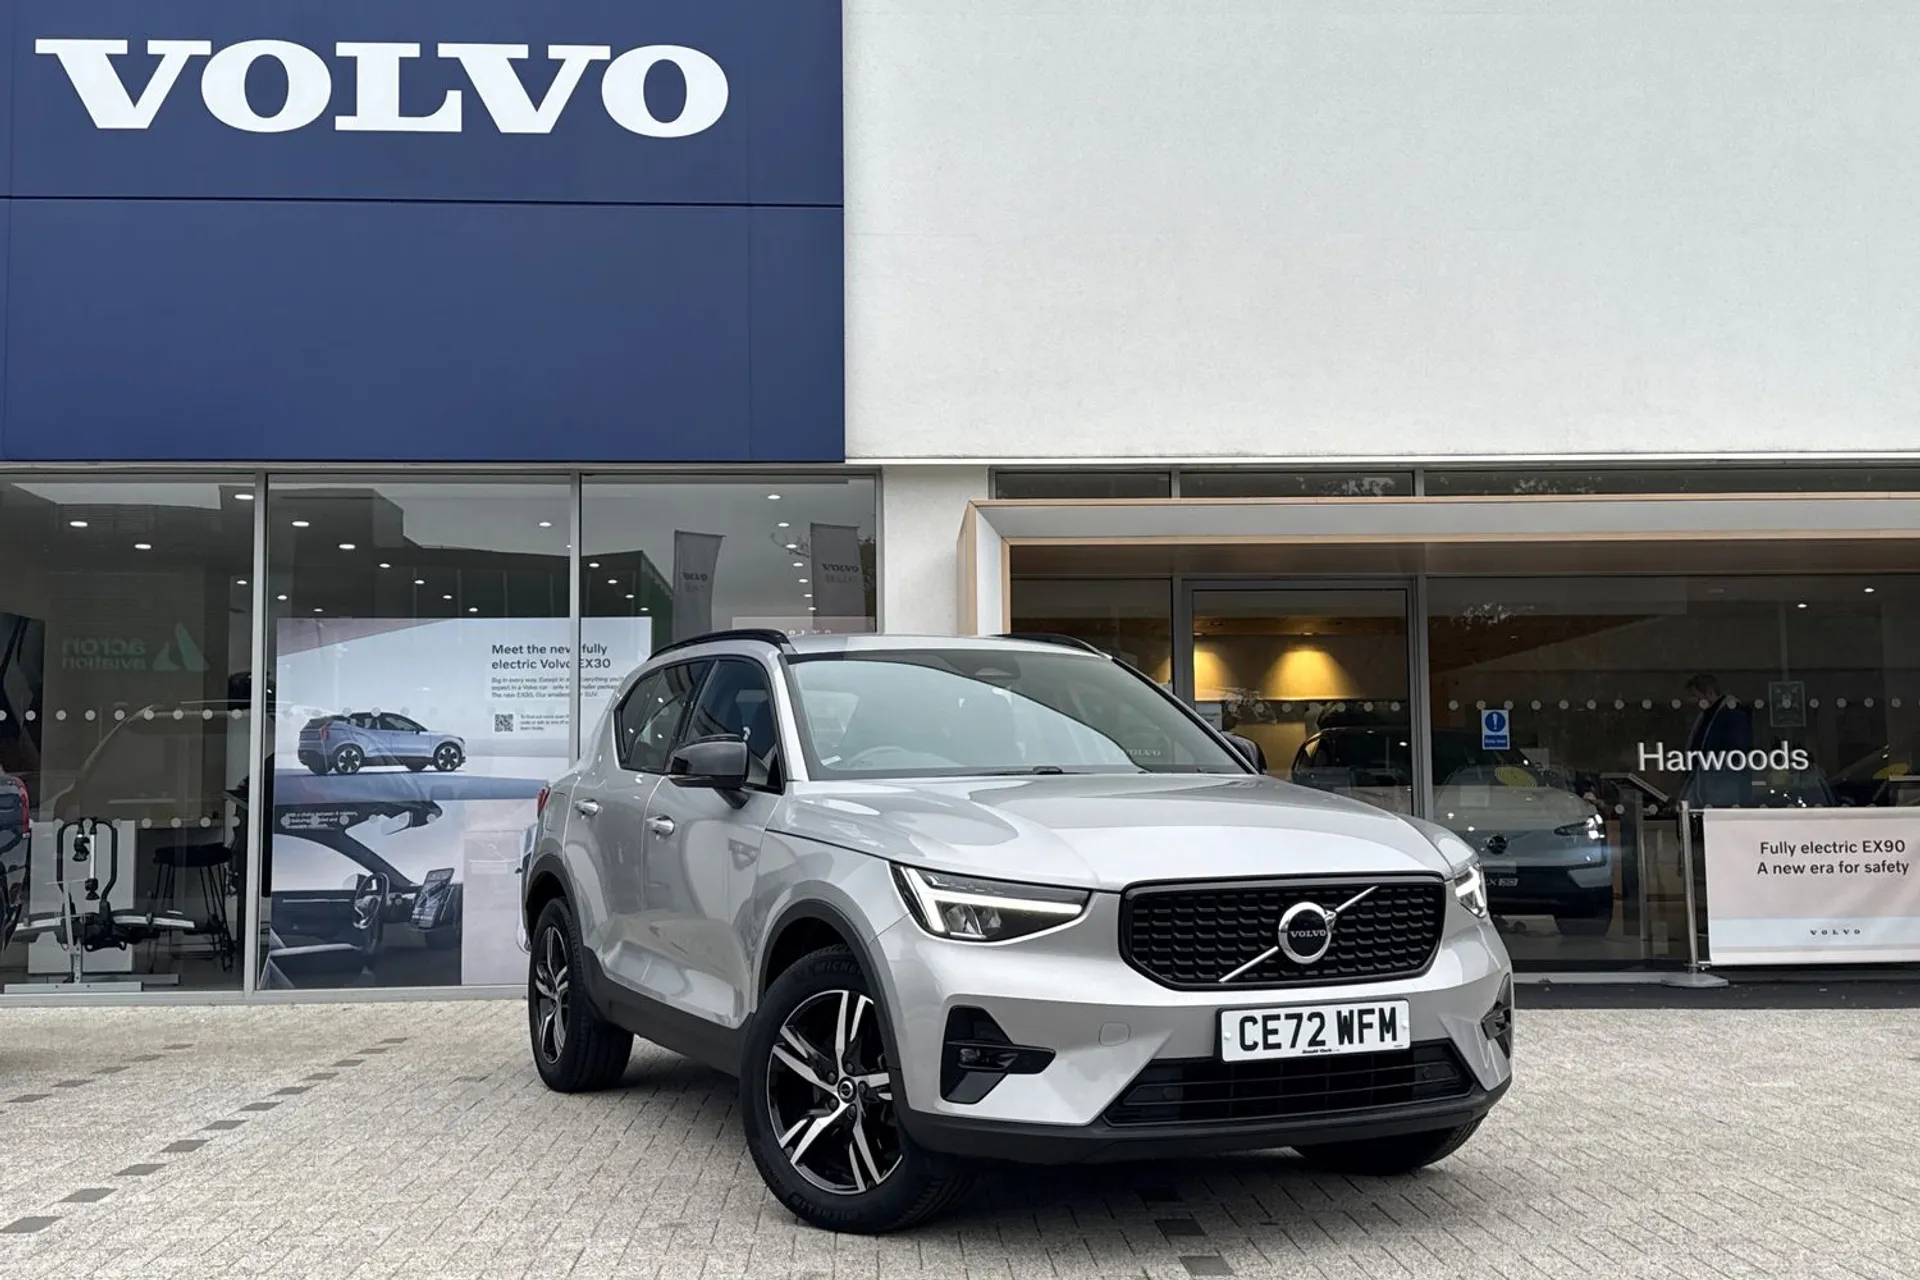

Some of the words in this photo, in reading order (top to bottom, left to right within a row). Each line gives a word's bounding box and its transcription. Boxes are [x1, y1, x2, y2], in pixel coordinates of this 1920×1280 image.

[35, 38, 729, 138] VOLVO
[491, 644, 524, 655] Meet
[527, 644, 547, 655] the
[582, 643, 608, 656] fully
[491, 659, 538, 670] electric
[1637, 740, 1809, 771] Harwoods
[1760, 841, 1797, 857] Fully
[1800, 840, 1858, 854] electric
[1862, 839, 1906, 853] EX90
[1757, 862, 1768, 875] A
[1772, 863, 1806, 875] new
[1810, 863, 1835, 874] era
[1838, 860, 1860, 874] for
[1864, 859, 1909, 875] safety
[1290, 929, 1326, 938] VOLVO
[1238, 1011, 1326, 1051] CE72
[1336, 1006, 1398, 1046] WFM
